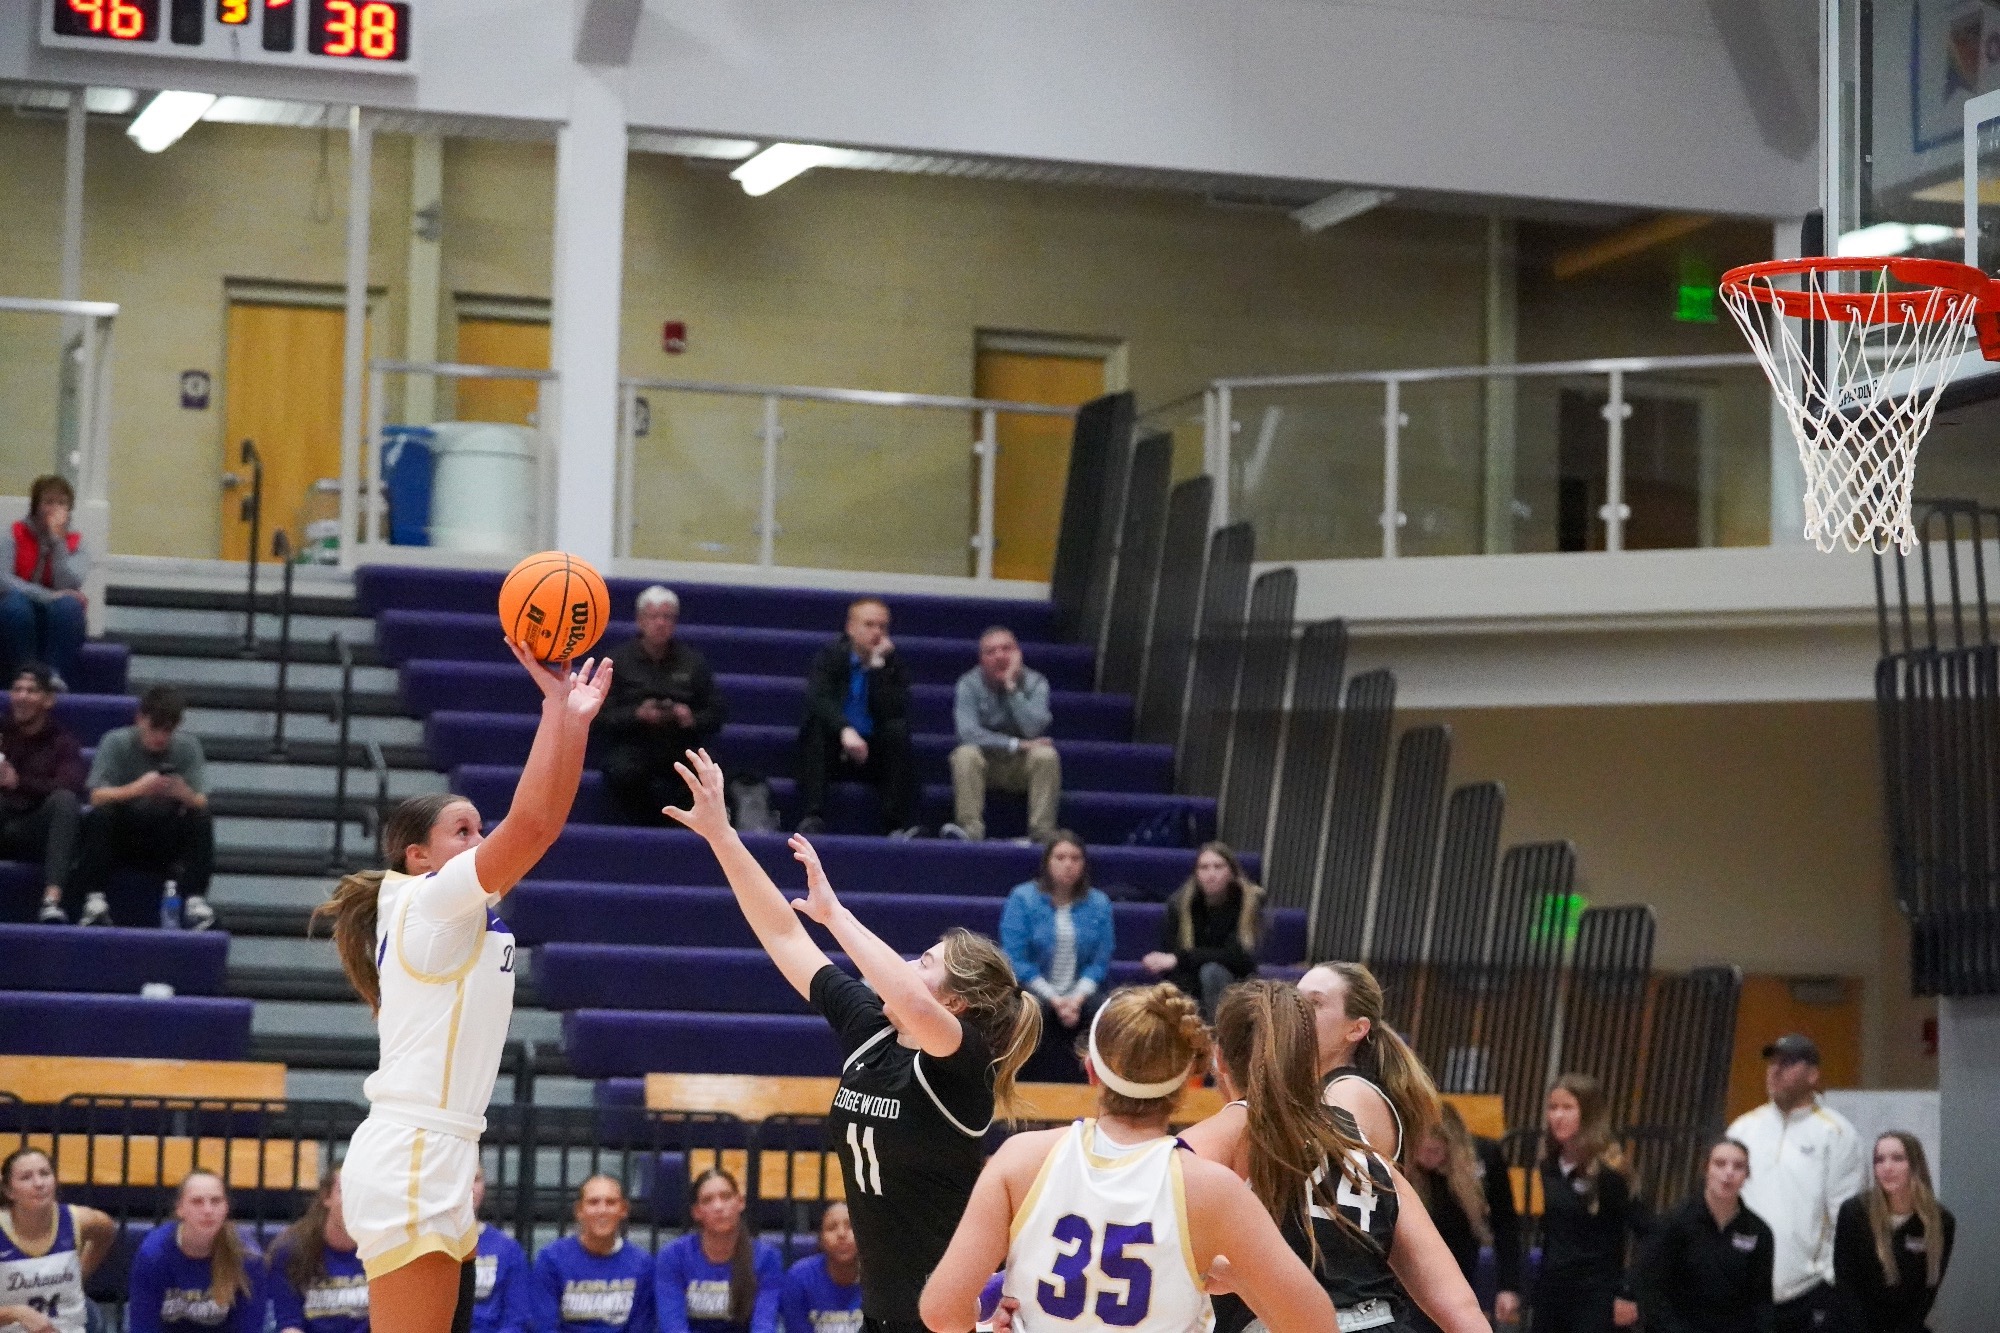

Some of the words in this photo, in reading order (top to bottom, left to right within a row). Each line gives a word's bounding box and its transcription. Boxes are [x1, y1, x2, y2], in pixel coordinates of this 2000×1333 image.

[322, 0, 398, 60] 38
[553, 600, 589, 662] Wilson
[833, 1086, 901, 1120] EDGEWOOD
[846, 1121, 884, 1197] 11
[1036, 1212, 1157, 1328] 35
